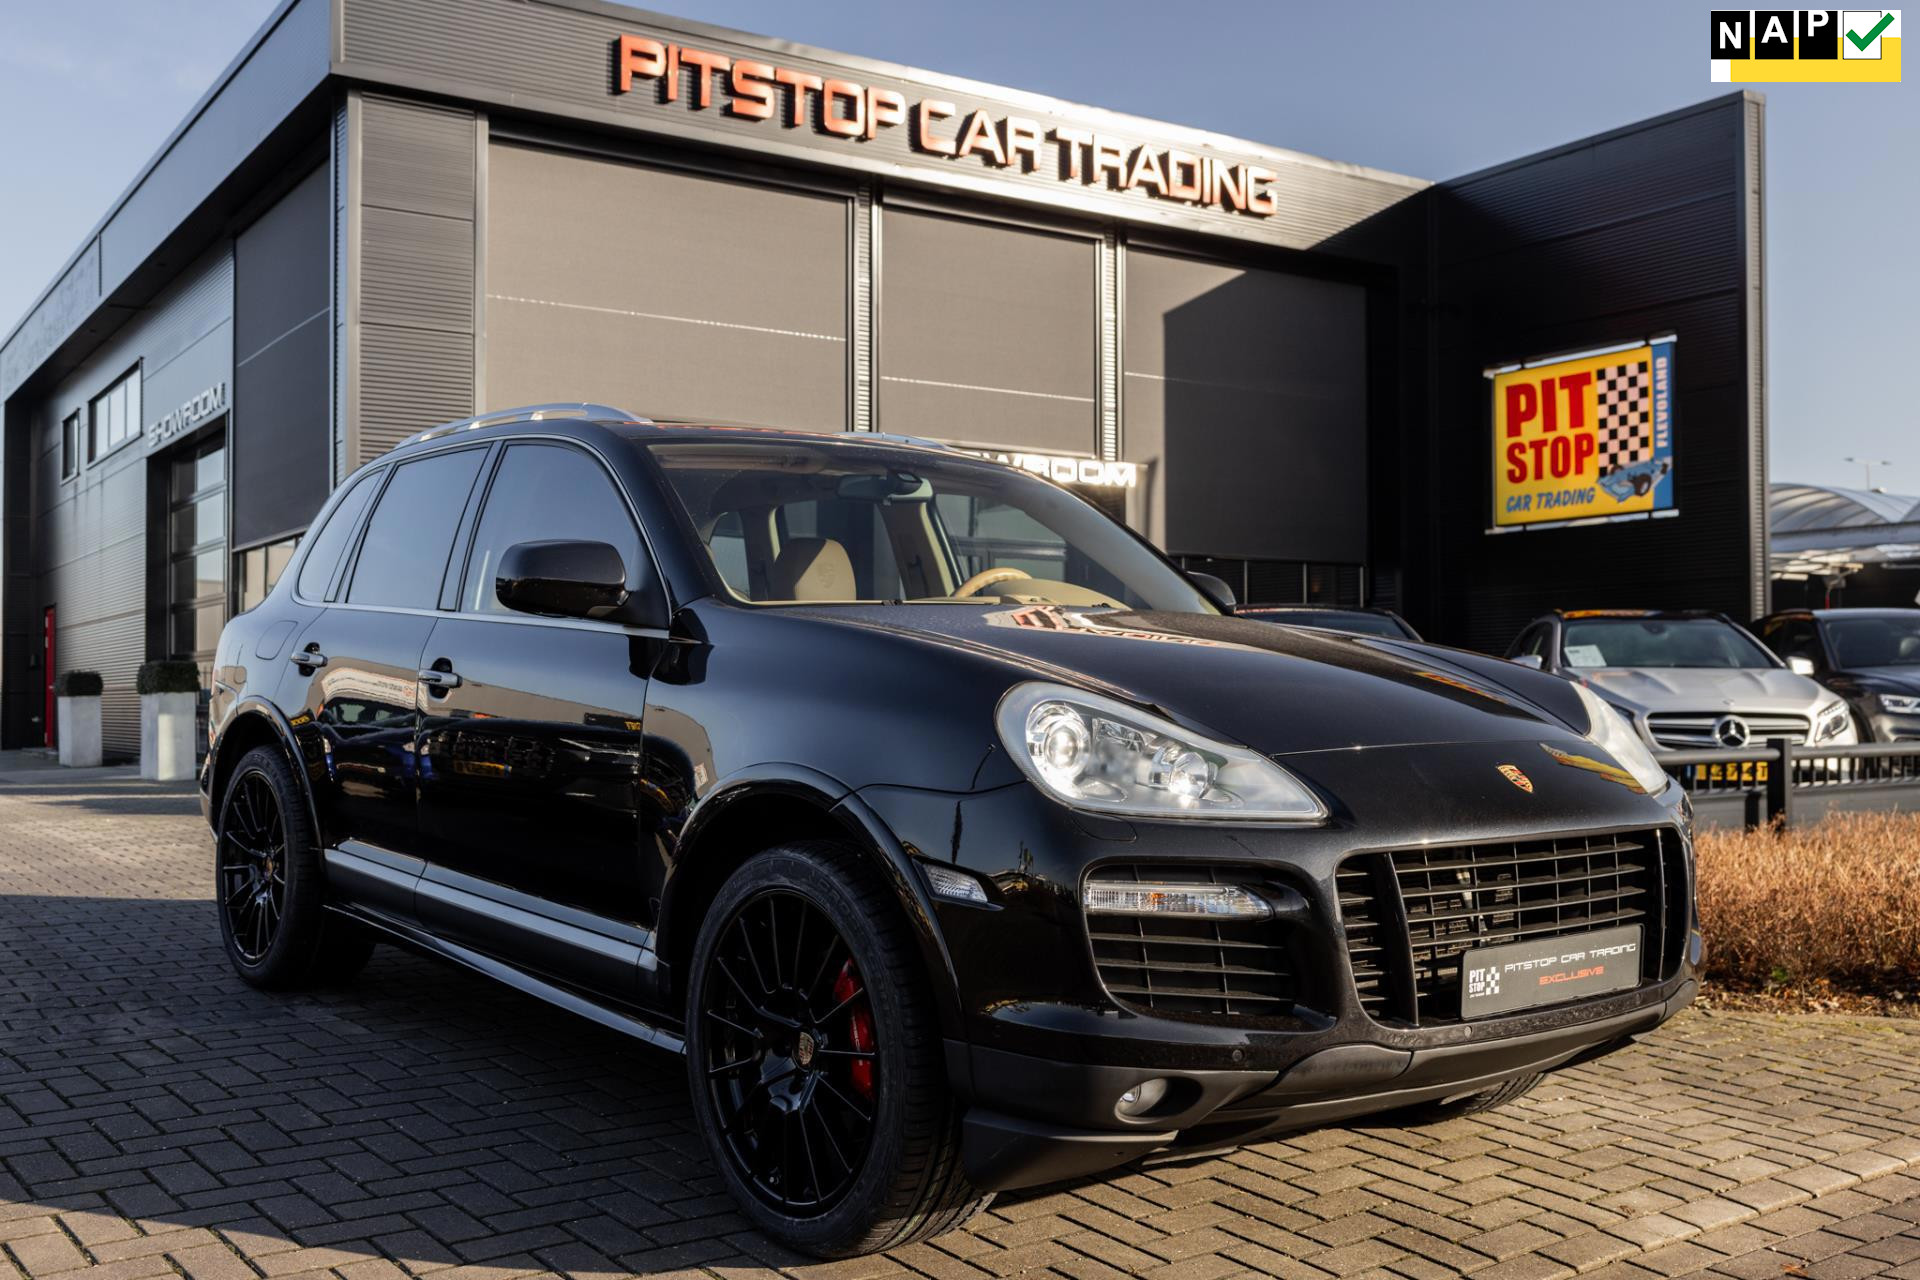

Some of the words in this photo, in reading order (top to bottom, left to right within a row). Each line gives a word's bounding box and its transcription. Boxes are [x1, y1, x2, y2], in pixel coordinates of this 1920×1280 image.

[614, 34, 906, 141] PITSTOP
[915, 99, 1044, 172] CAR
[1053, 126, 1279, 216] TRADING
[148, 382, 225, 448] SHOWROOM
[1505, 371, 1592, 438] PIT
[1506, 433, 1594, 484] STOP
[1506, 494, 1532, 513] CAR
[1536, 487, 1595, 509] TRADING
[1504, 957, 1557, 973] PITSTOP
[1560, 952, 1586, 964] CAR
[1589, 943, 1637, 958] TRADING
[1469, 968, 1485, 983] PIT
[1469, 981, 1485, 994] STOP
[1539, 966, 1604, 986] EXCLUSIVE
